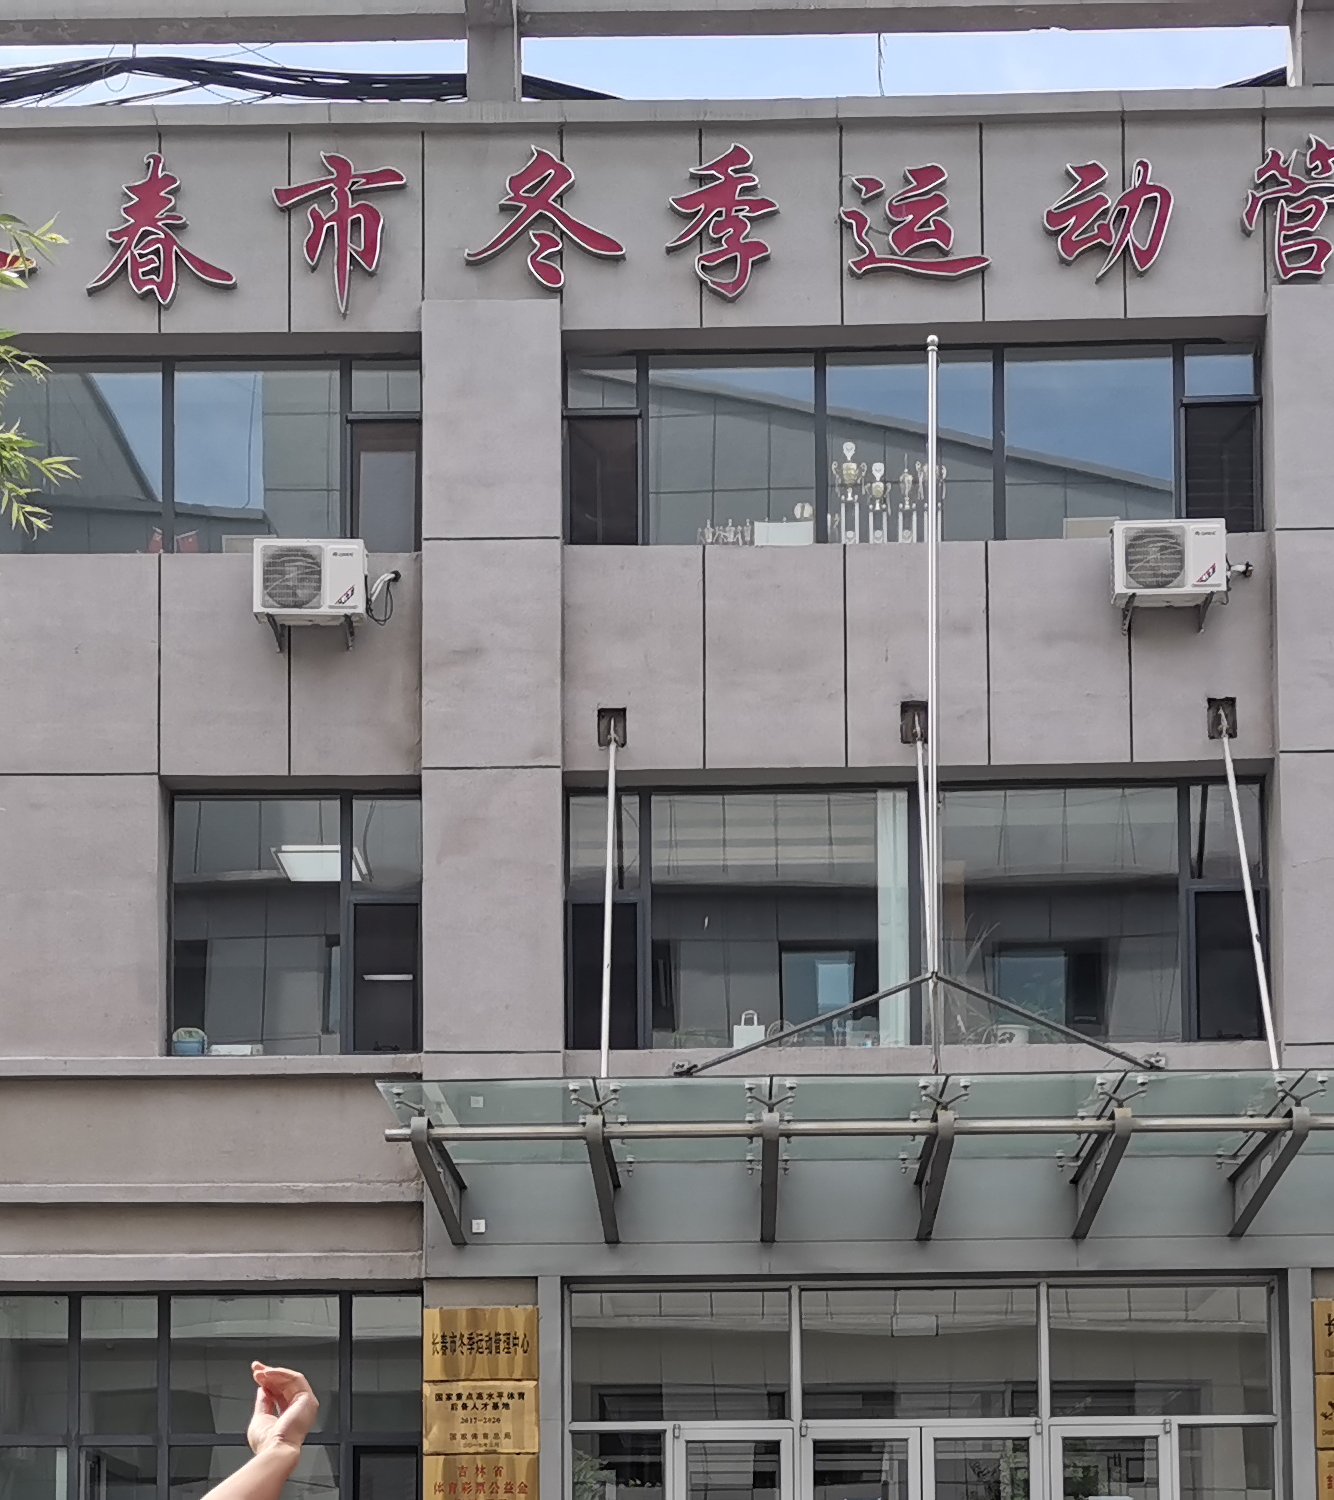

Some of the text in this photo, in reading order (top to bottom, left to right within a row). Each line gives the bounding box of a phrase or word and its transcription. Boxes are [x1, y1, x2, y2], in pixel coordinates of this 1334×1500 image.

[431, 1331, 530, 1356] 长春市冬季运动管理中心
[434, 1391, 526, 1402] 国家重点高水平体育
[457, 1465, 504, 1478] 吉林省
[433, 1481, 529, 1495] 体育彩票公益金
